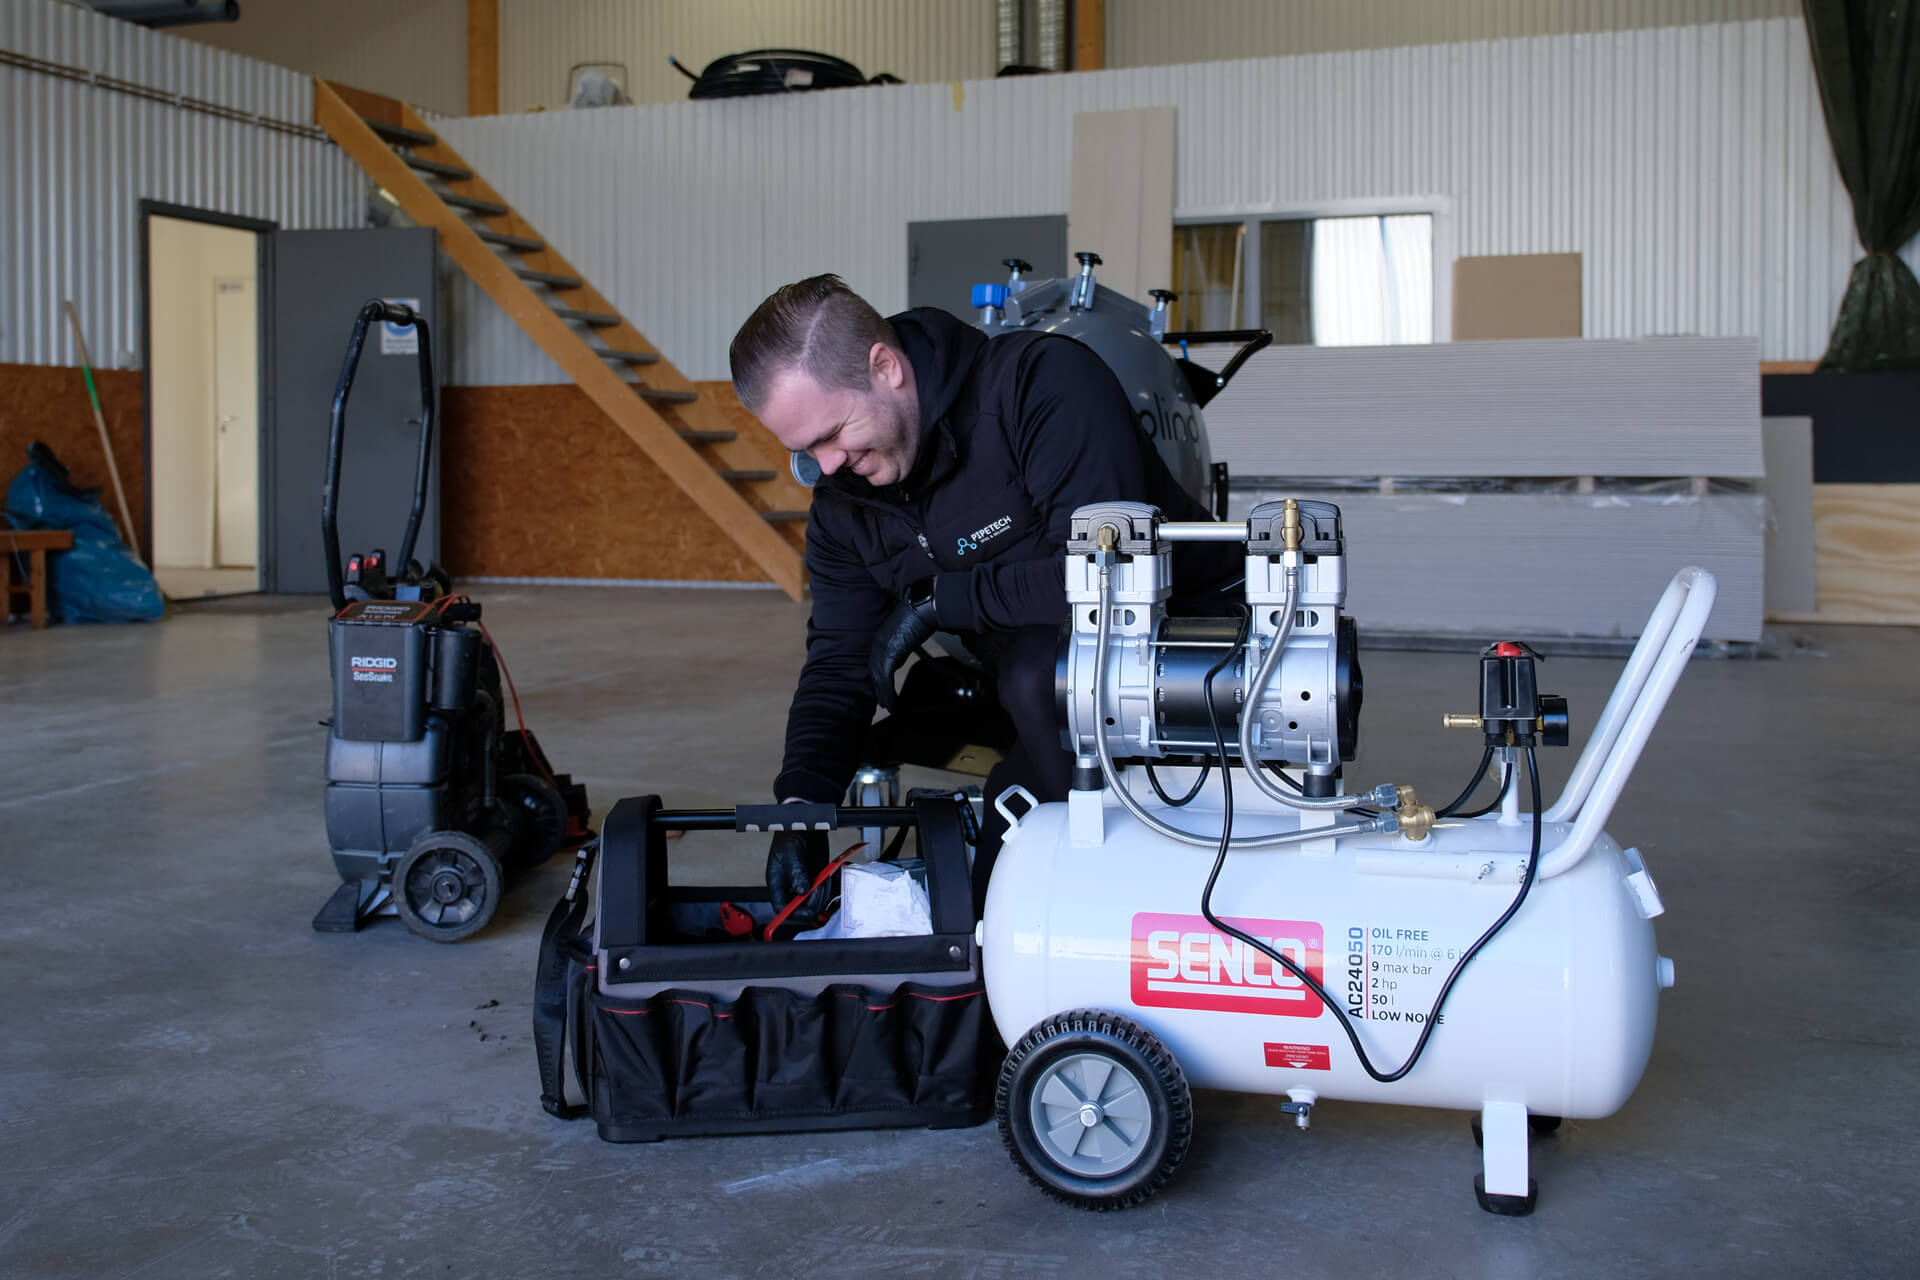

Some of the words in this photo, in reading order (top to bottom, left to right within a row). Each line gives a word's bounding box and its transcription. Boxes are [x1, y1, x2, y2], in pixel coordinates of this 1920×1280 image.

[970, 515, 1012, 542] PIPETECH
[351, 656, 398, 669] RIDGID
[352, 671, 393, 683] SeeSnake
[1372, 928, 1393, 940] OIL
[1397, 929, 1429, 941] FREE
[1371, 944, 1392, 956] 170
[1447, 948, 1455, 960] 6
[1348, 927, 1363, 1019] AC24050
[1371, 961, 1379, 972] 9
[1383, 963, 1409, 975] max
[1413, 963, 1432, 975] bar
[1371, 978, 1379, 989] 2
[1382, 978, 1398, 991] hp
[1371, 994, 1388, 1005] 50
[1372, 1010, 1401, 1022] LOW
[1405, 1012, 1445, 1025] NOIE
